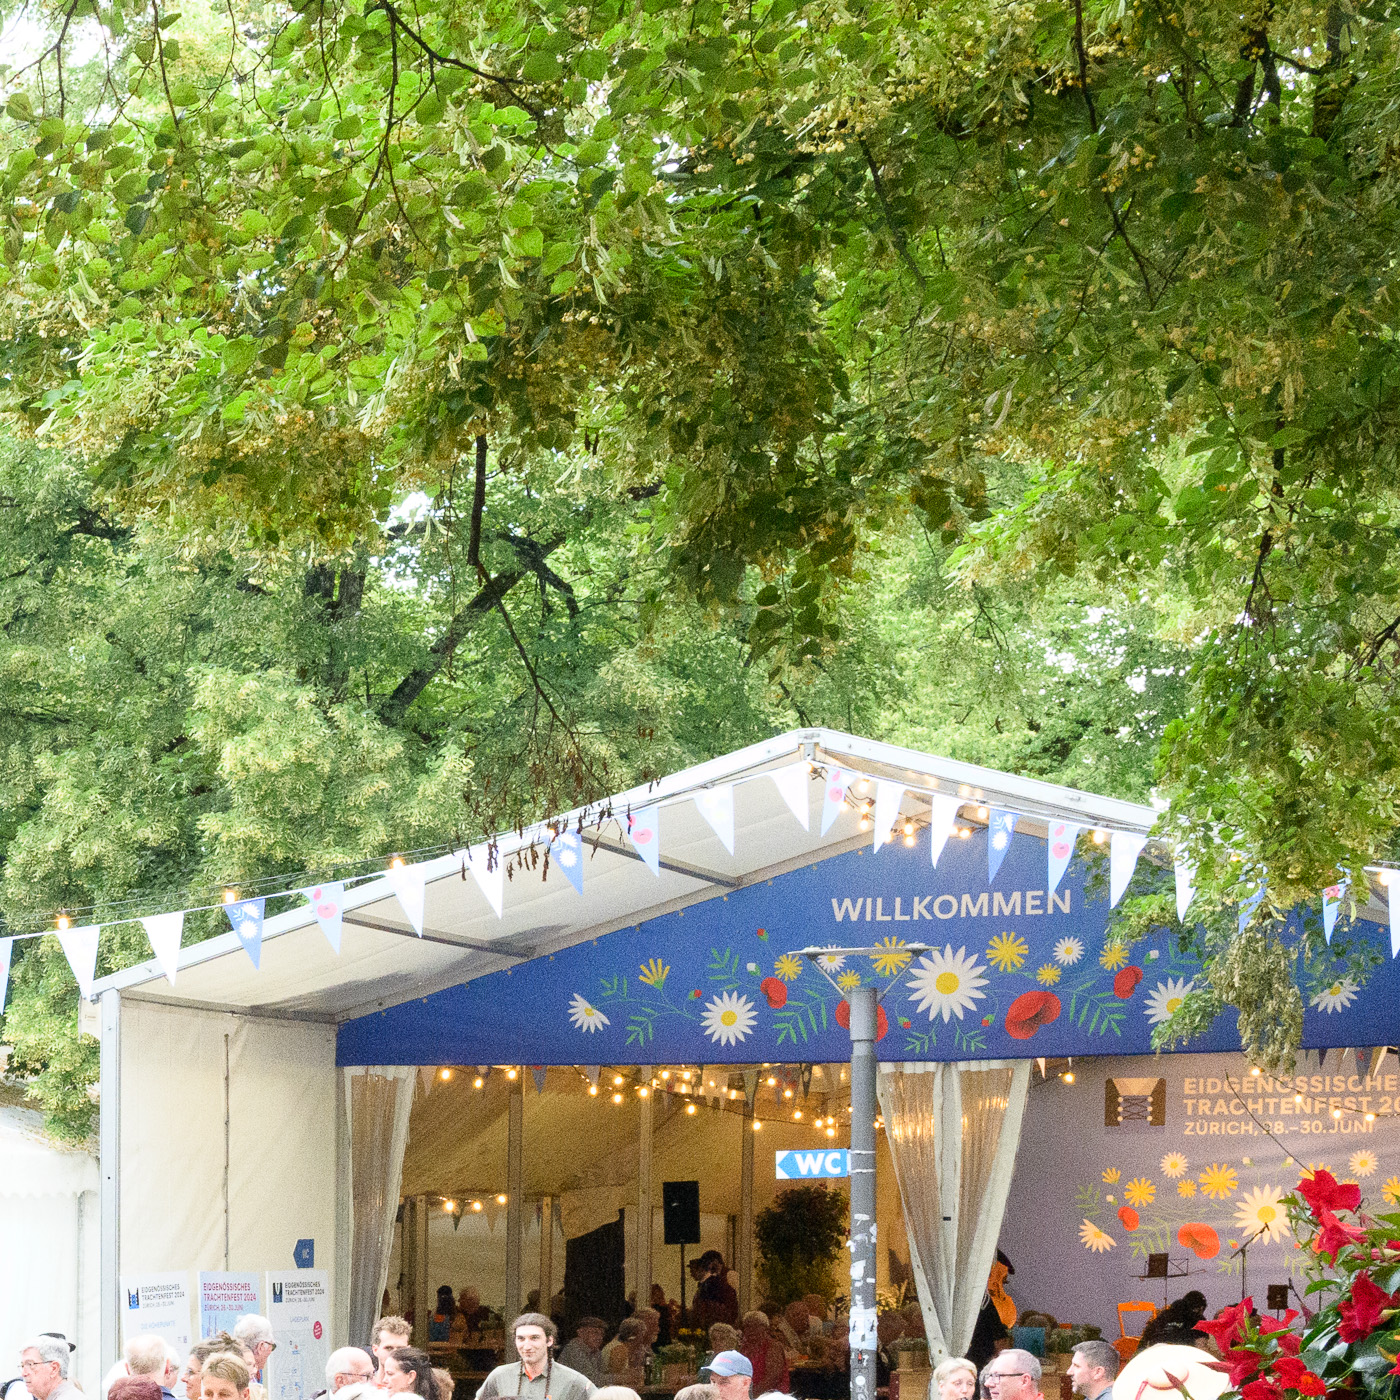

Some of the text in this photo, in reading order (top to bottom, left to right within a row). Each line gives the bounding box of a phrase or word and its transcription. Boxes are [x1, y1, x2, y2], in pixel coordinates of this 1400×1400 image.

[831, 889, 1071, 922] WILLKOMMEN
[1183, 1096, 1372, 1116] TRACHTENFEST
[1183, 1119, 1258, 1137] ZÜRICH,
[794, 1152, 841, 1175] WC
[204, 1293, 257, 1301] TRACHTENFEST 2024
